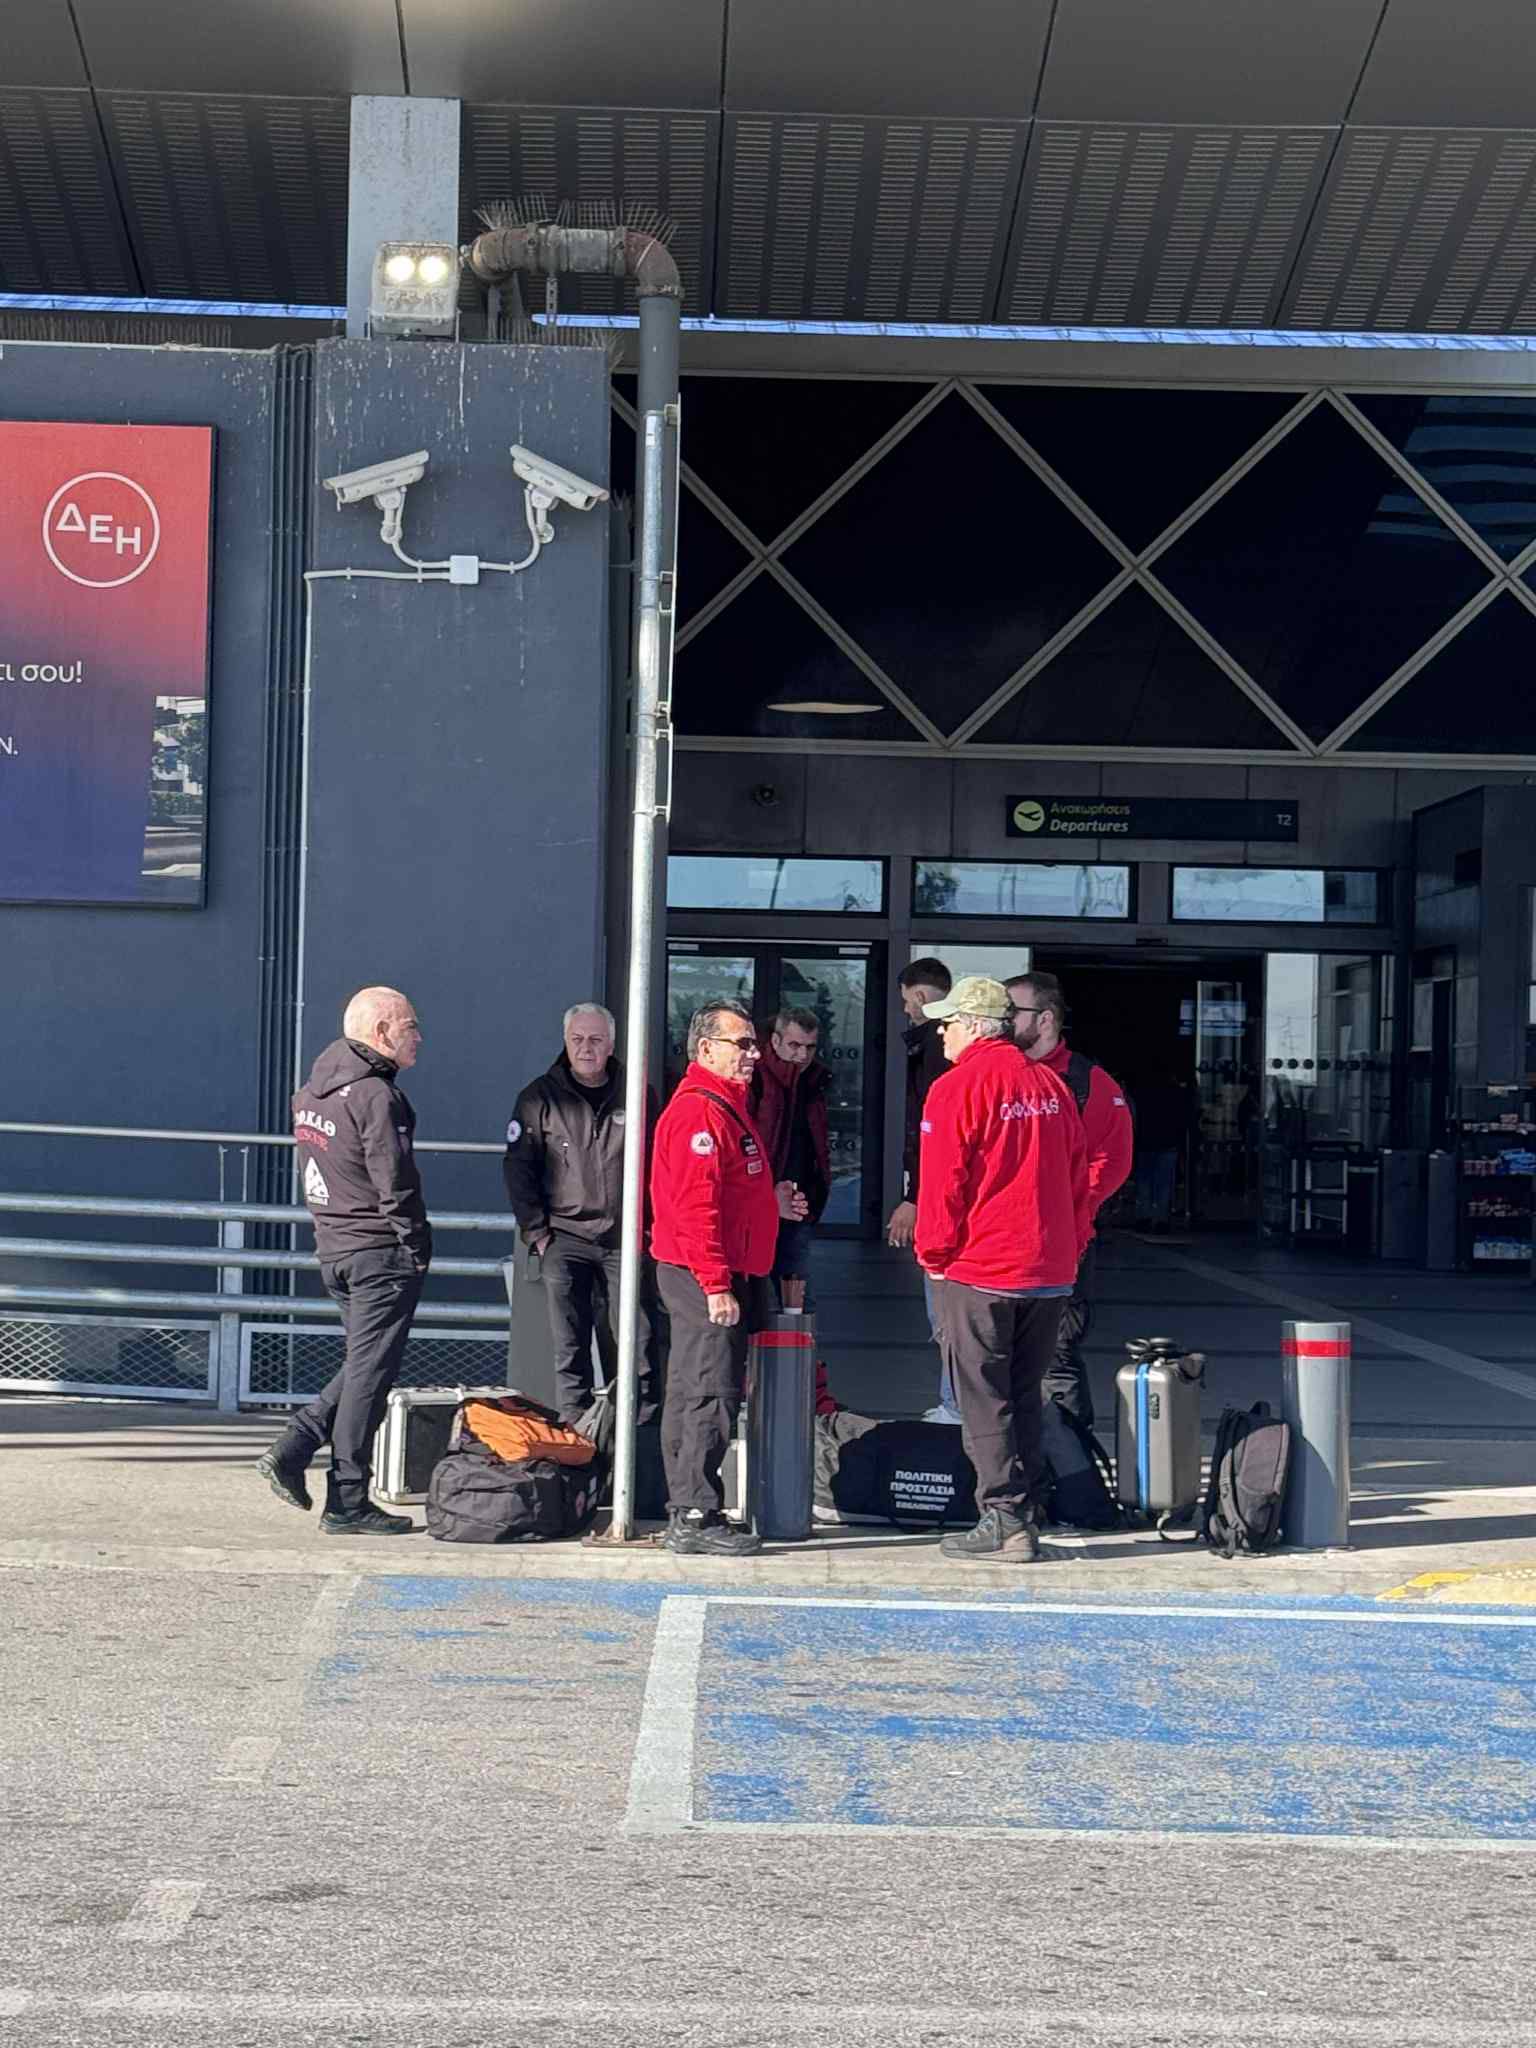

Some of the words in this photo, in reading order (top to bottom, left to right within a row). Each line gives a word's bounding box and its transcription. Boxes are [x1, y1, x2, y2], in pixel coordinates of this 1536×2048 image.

[56, 503, 141, 555] ΔΕΗ
[21, 660, 83, 683] σου!
[1050, 818, 1129, 834] Departures
[1276, 813, 1292, 827] T2
[895, 1470, 952, 1483] ΠΟΛΙΤΙΚΗ
[890, 1481, 955, 1495] ΠΡΟΣΤΑΣΙΑ
